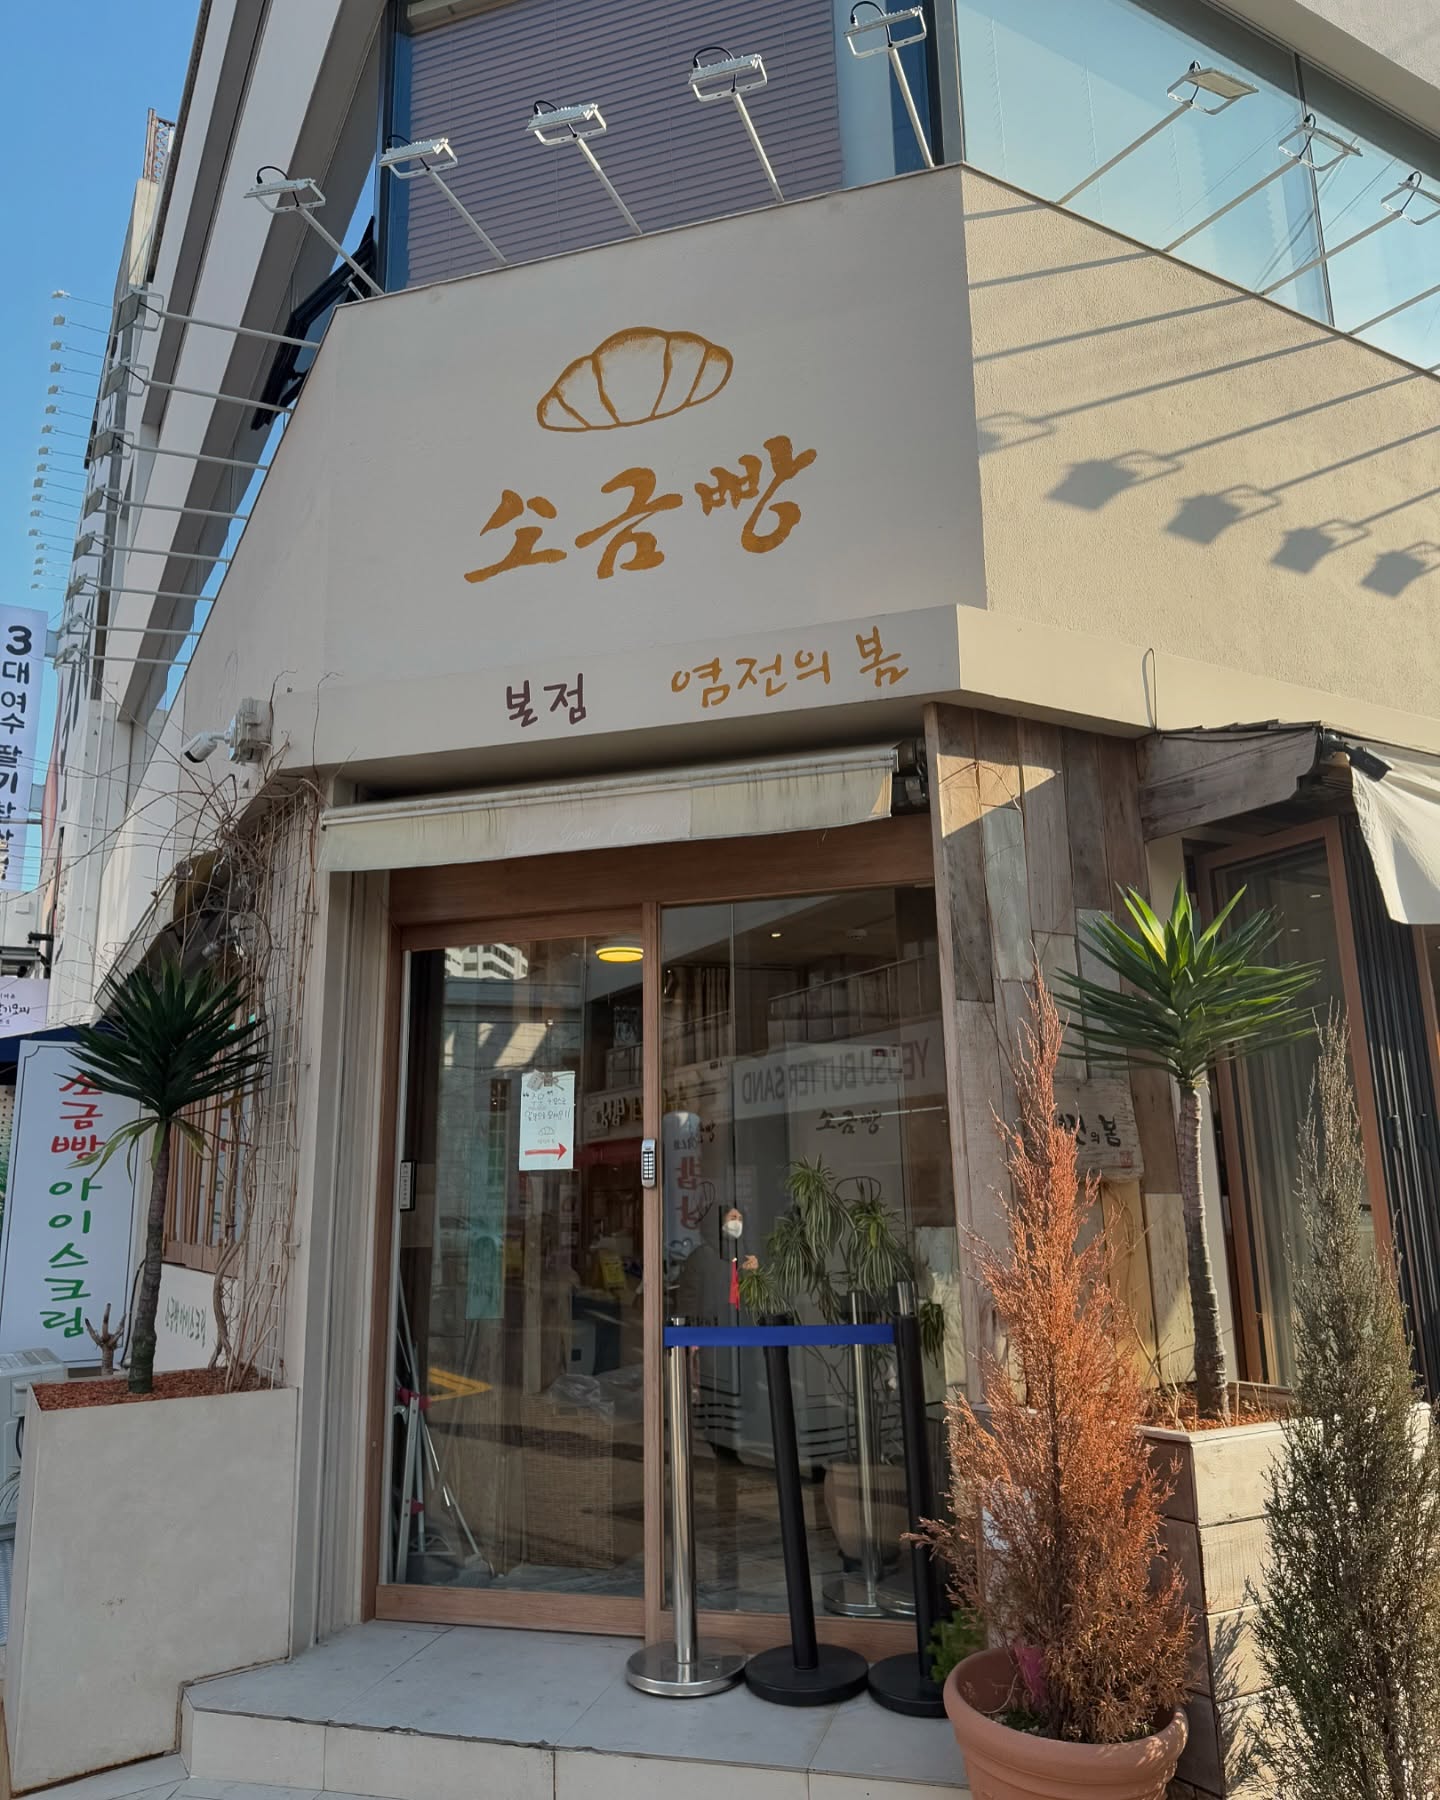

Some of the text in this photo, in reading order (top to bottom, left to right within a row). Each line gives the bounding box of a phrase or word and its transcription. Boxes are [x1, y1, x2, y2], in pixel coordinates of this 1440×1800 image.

[464, 435, 817, 583] 소금빵
[506, 672, 587, 727] 본점
[671, 626, 909, 708] 염전의 봄
[39, 1178, 103, 1338] 아이스크림
